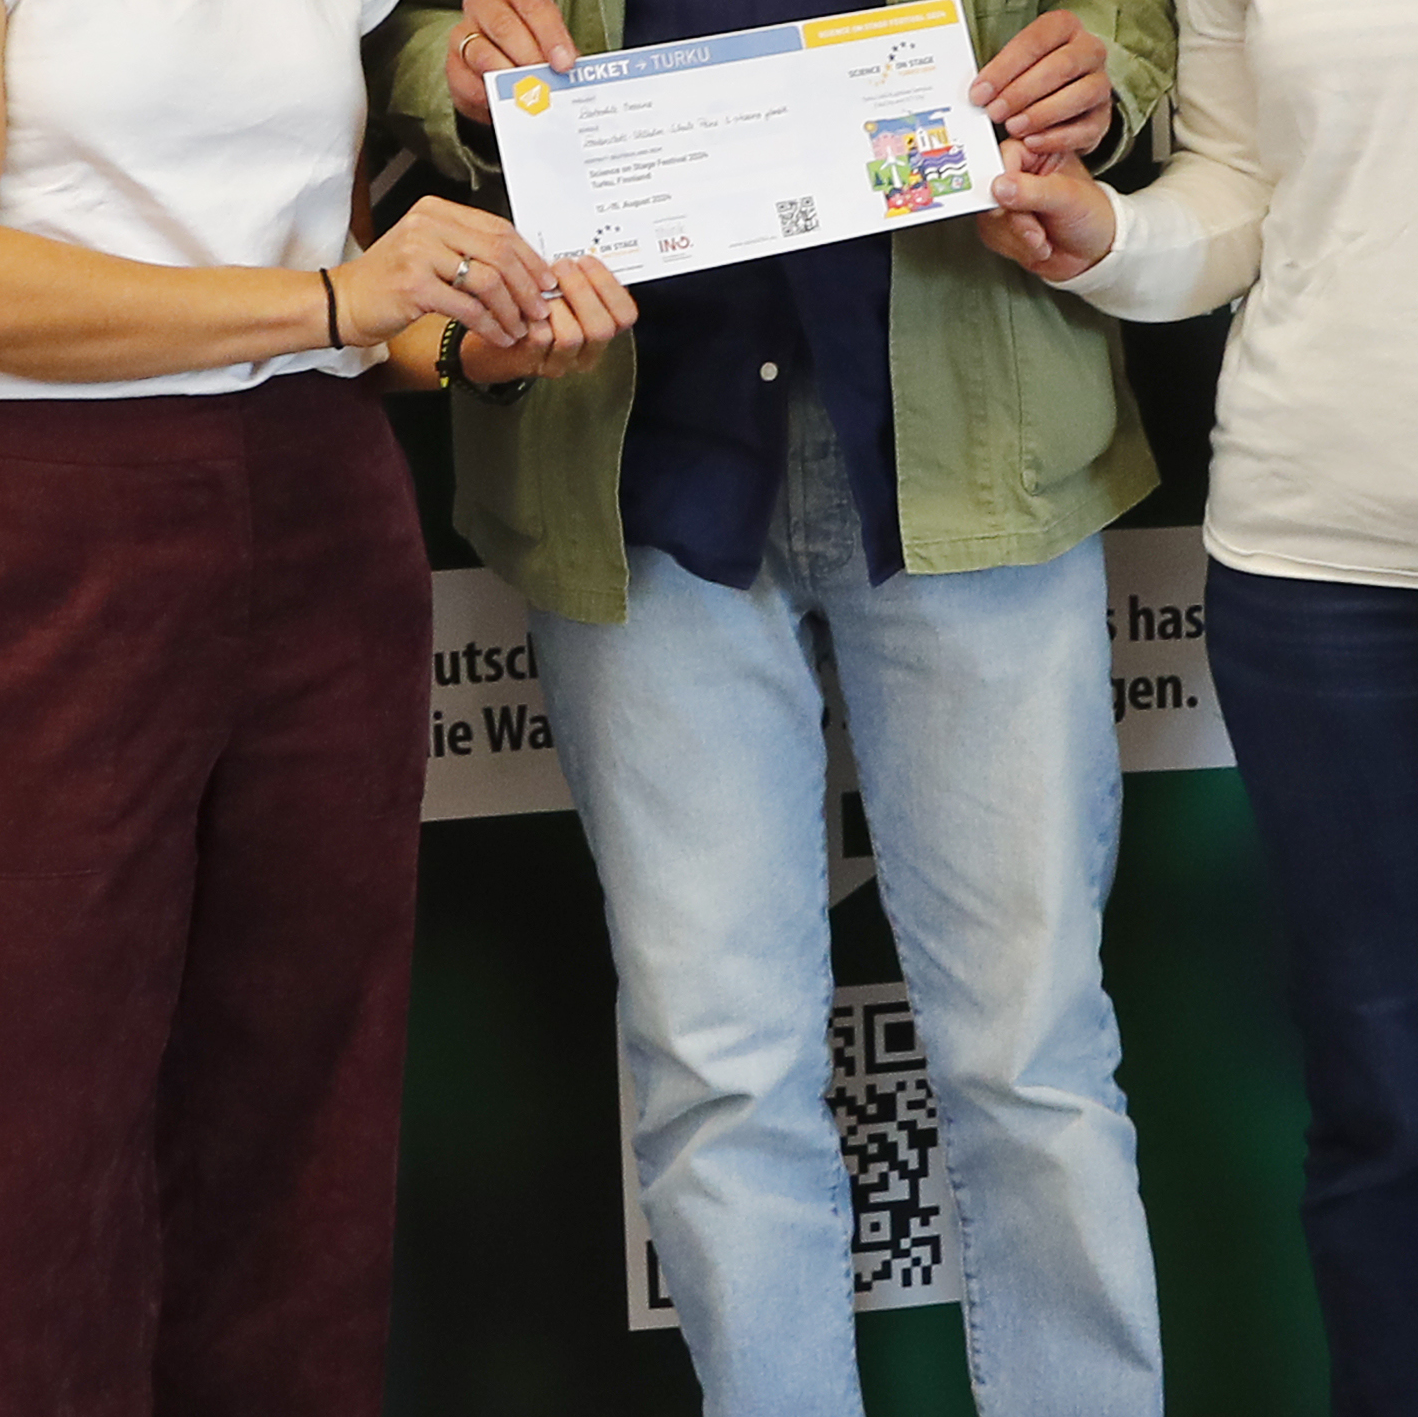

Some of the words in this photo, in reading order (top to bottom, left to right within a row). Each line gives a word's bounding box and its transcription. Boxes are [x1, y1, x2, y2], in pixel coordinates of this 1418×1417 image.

[568, 59, 630, 83] TICKET
[650, 46, 711, 69] TURKU
[429, 710, 474, 758] ie
